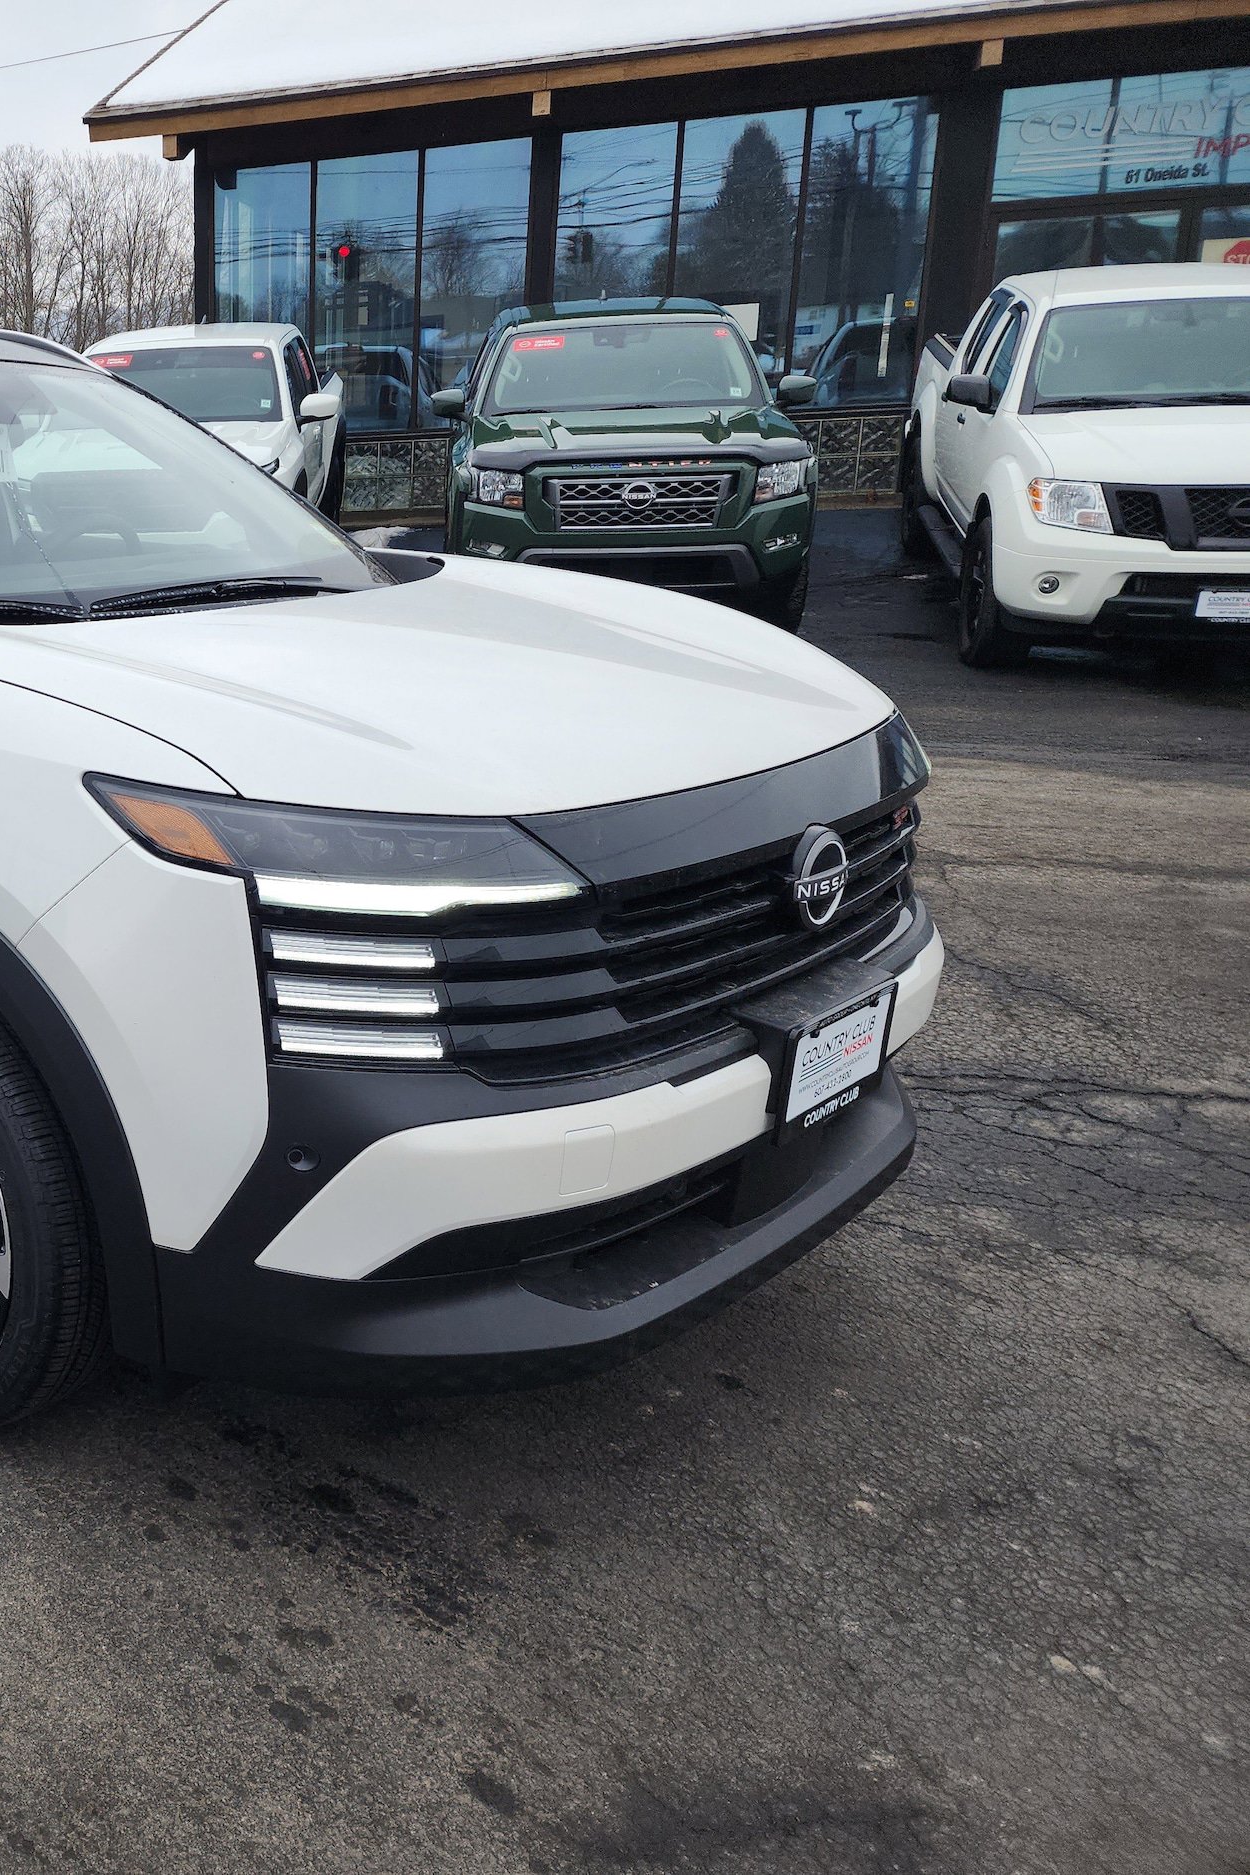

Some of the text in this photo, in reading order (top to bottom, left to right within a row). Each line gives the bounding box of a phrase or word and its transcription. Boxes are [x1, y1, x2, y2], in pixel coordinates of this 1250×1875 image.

[1019, 99, 1224, 144] COUNTRY
[1124, 168, 1140, 184] 61
[1144, 165, 1189, 183] Oneida
[802, 1014, 876, 1067] COUNTRY CLUB
[842, 1033, 874, 1058] NISSAN
[803, 1085, 860, 1128] COUNTRY CLUB
